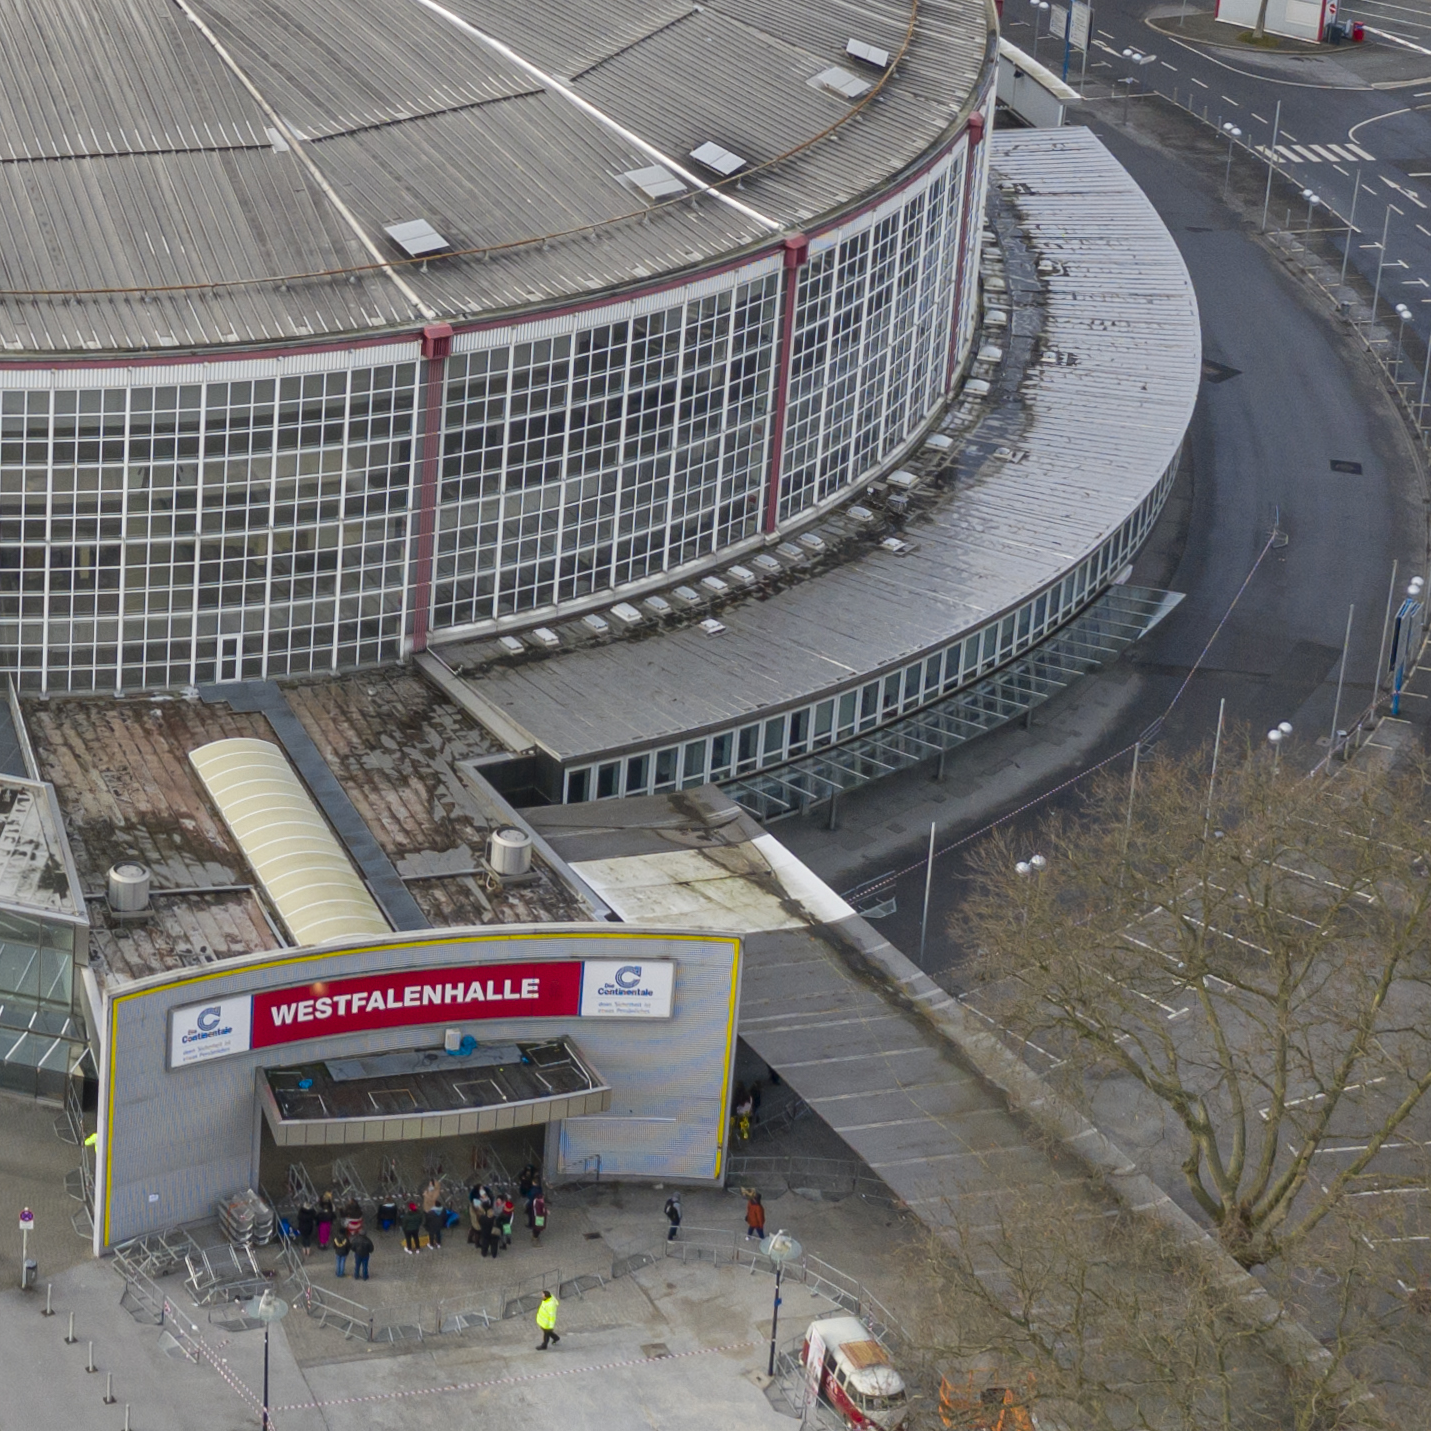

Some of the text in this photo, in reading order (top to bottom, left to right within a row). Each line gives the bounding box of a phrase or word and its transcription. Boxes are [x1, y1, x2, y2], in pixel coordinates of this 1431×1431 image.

[597, 987, 653, 996] Continentale
[270, 978, 540, 1027] WESTFALENHALLE
[181, 1026, 233, 1044] Continentale
